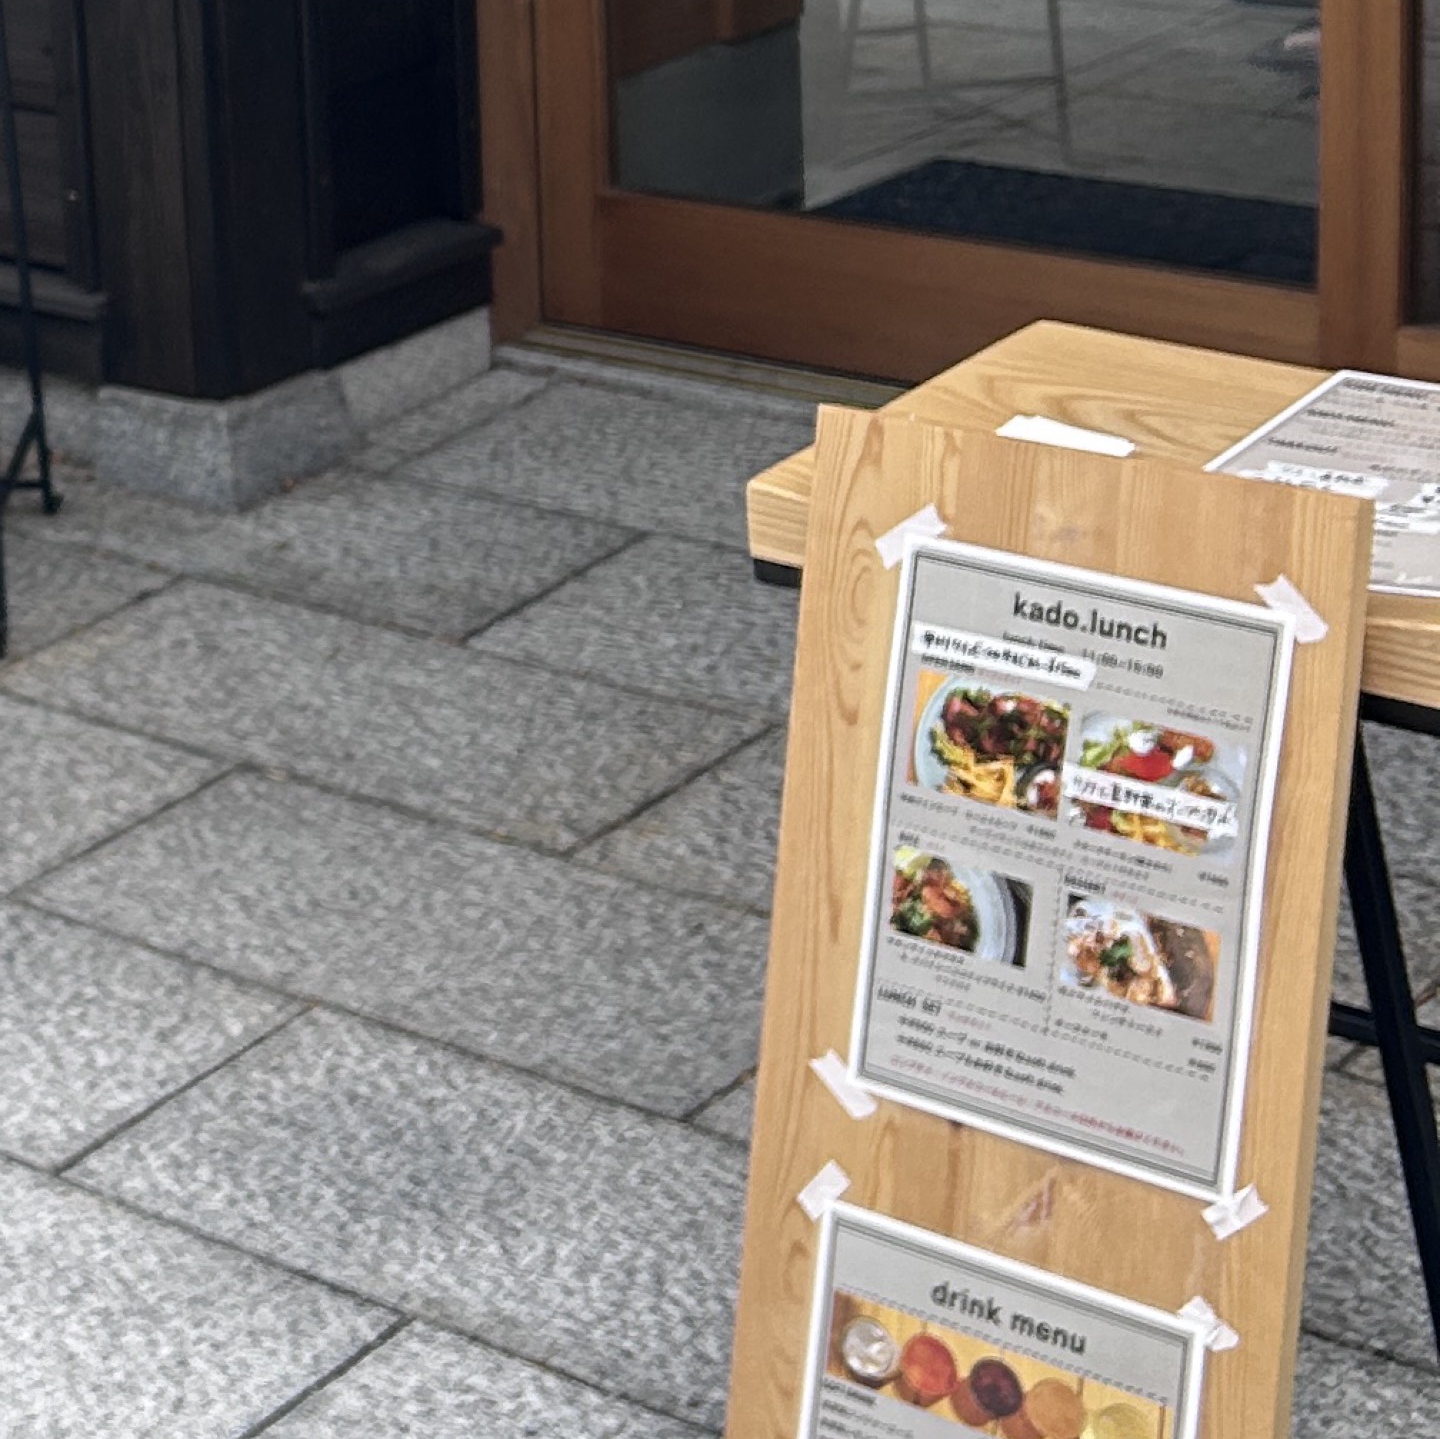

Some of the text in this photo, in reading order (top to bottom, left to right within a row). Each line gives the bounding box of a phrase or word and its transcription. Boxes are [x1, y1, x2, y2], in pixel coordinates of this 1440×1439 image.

[1013, 591, 1168, 650] kado.lunch
[930, 1281, 1088, 1356] drink menu
